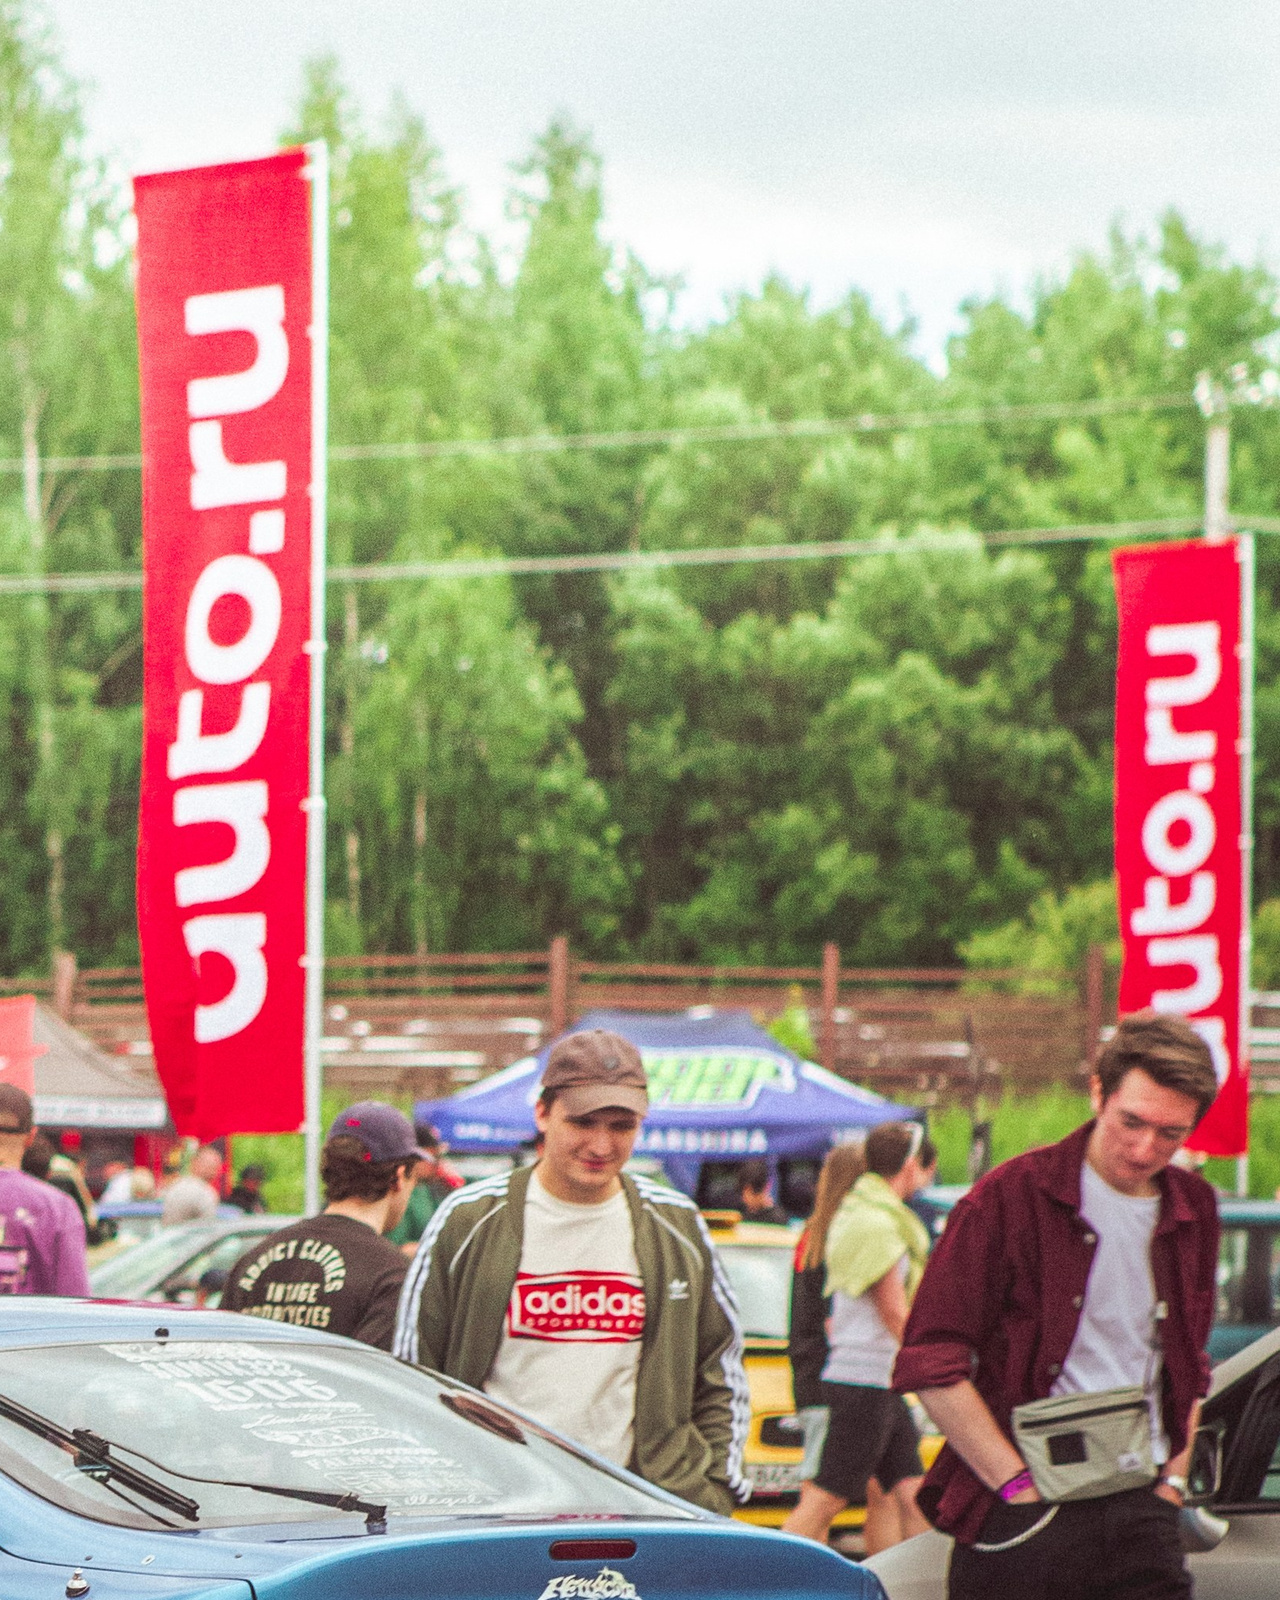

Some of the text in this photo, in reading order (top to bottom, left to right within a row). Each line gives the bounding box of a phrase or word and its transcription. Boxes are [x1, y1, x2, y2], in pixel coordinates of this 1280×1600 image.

[168, 284, 291, 1043] auto.ru
[237, 1239, 299, 1293] ADDICT
[524, 1285, 646, 1318] adidas
[176, 1378, 338, 1404] 1606
